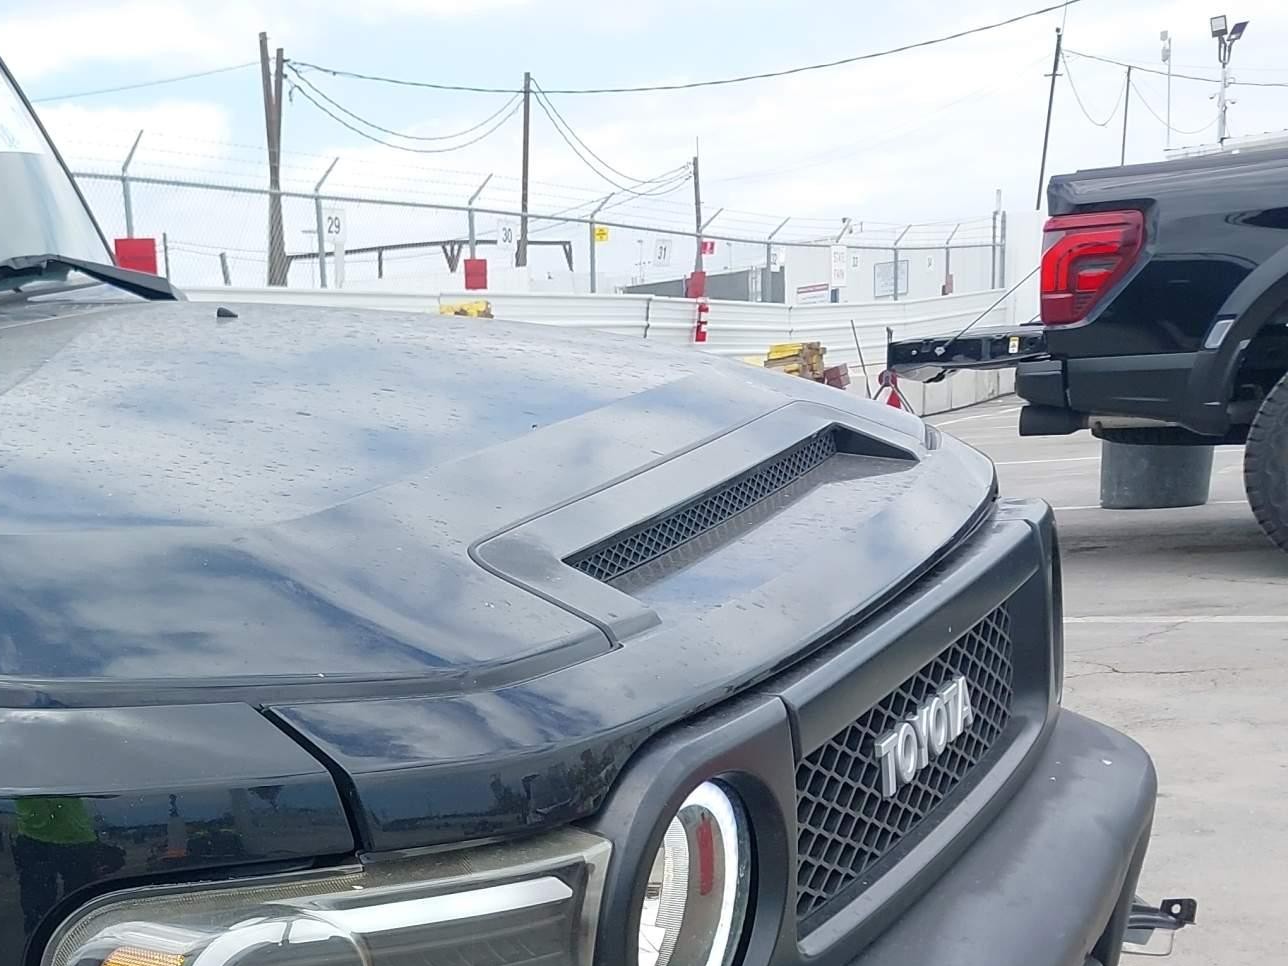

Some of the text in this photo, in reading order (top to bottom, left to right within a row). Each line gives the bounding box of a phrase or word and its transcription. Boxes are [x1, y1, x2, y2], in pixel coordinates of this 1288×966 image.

[327, 216, 341, 234] 29
[502, 227, 513, 243] 30
[657, 245, 667, 260] 31
[875, 675, 974, 800] TOYOTA
